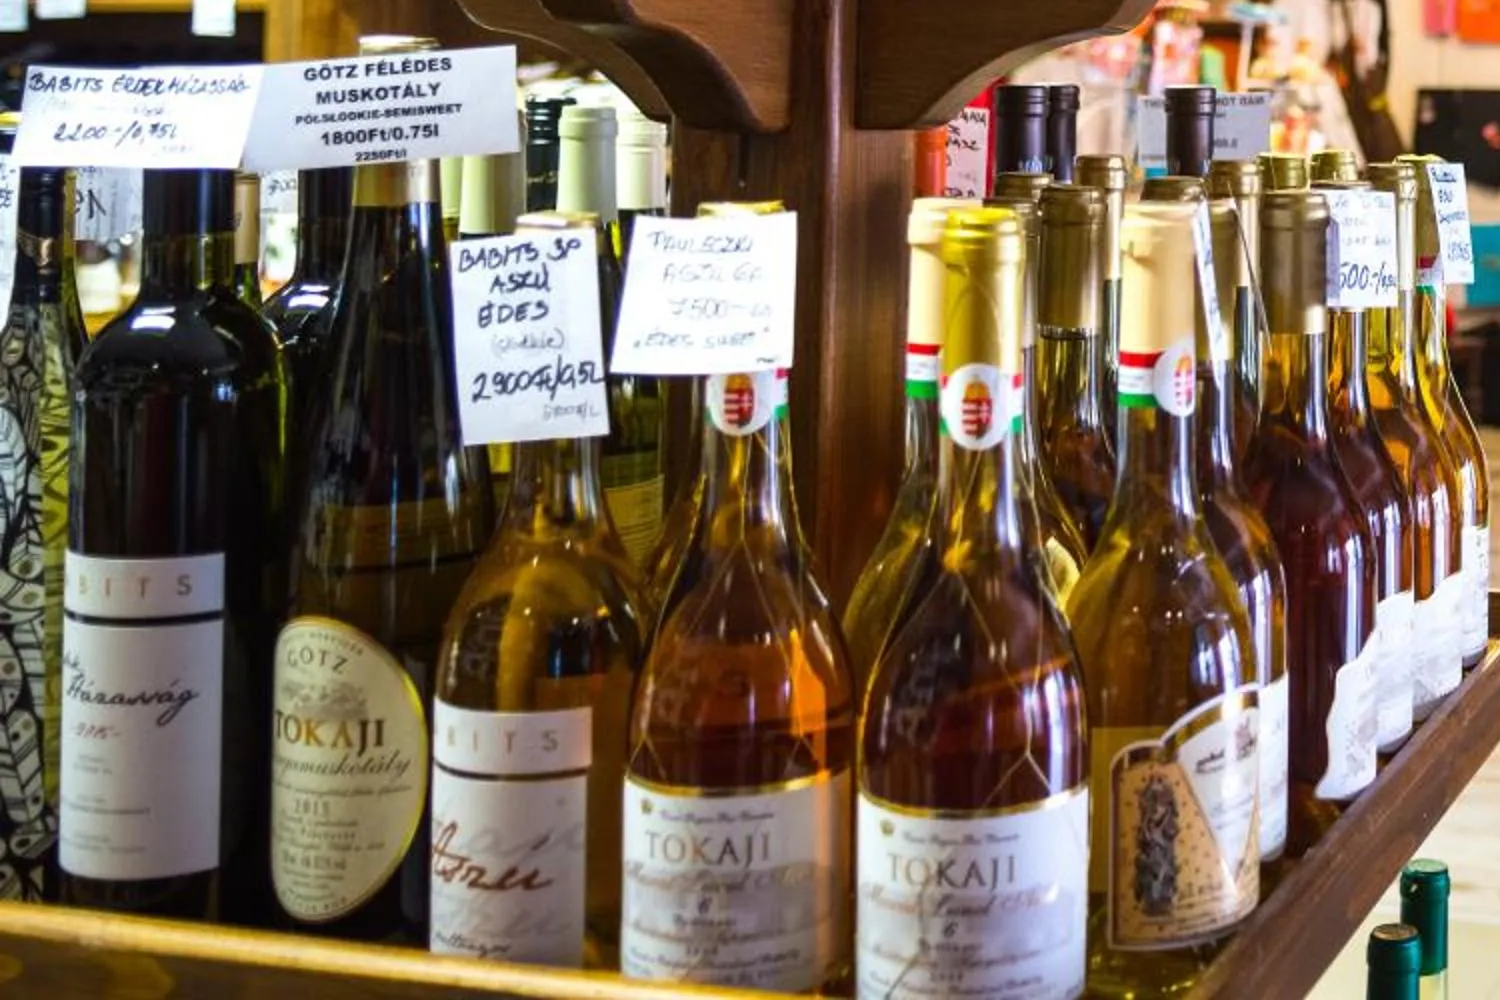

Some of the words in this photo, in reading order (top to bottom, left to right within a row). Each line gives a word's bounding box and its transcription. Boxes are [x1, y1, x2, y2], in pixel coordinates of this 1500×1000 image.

[28, 72, 104, 94] BABITS
[303, 63, 359, 82] GÖTZ
[364, 57, 452, 78] FÉLÉDES
[315, 82, 442, 105] MUSKOTÁLY
[458, 241, 540, 273] BABITS
[478, 300, 550, 329] ÉDES
[274, 709, 387, 757] TOKAJI
[645, 830, 771, 868] TOKAJI
[887, 852, 1016, 892] TOKAJI
